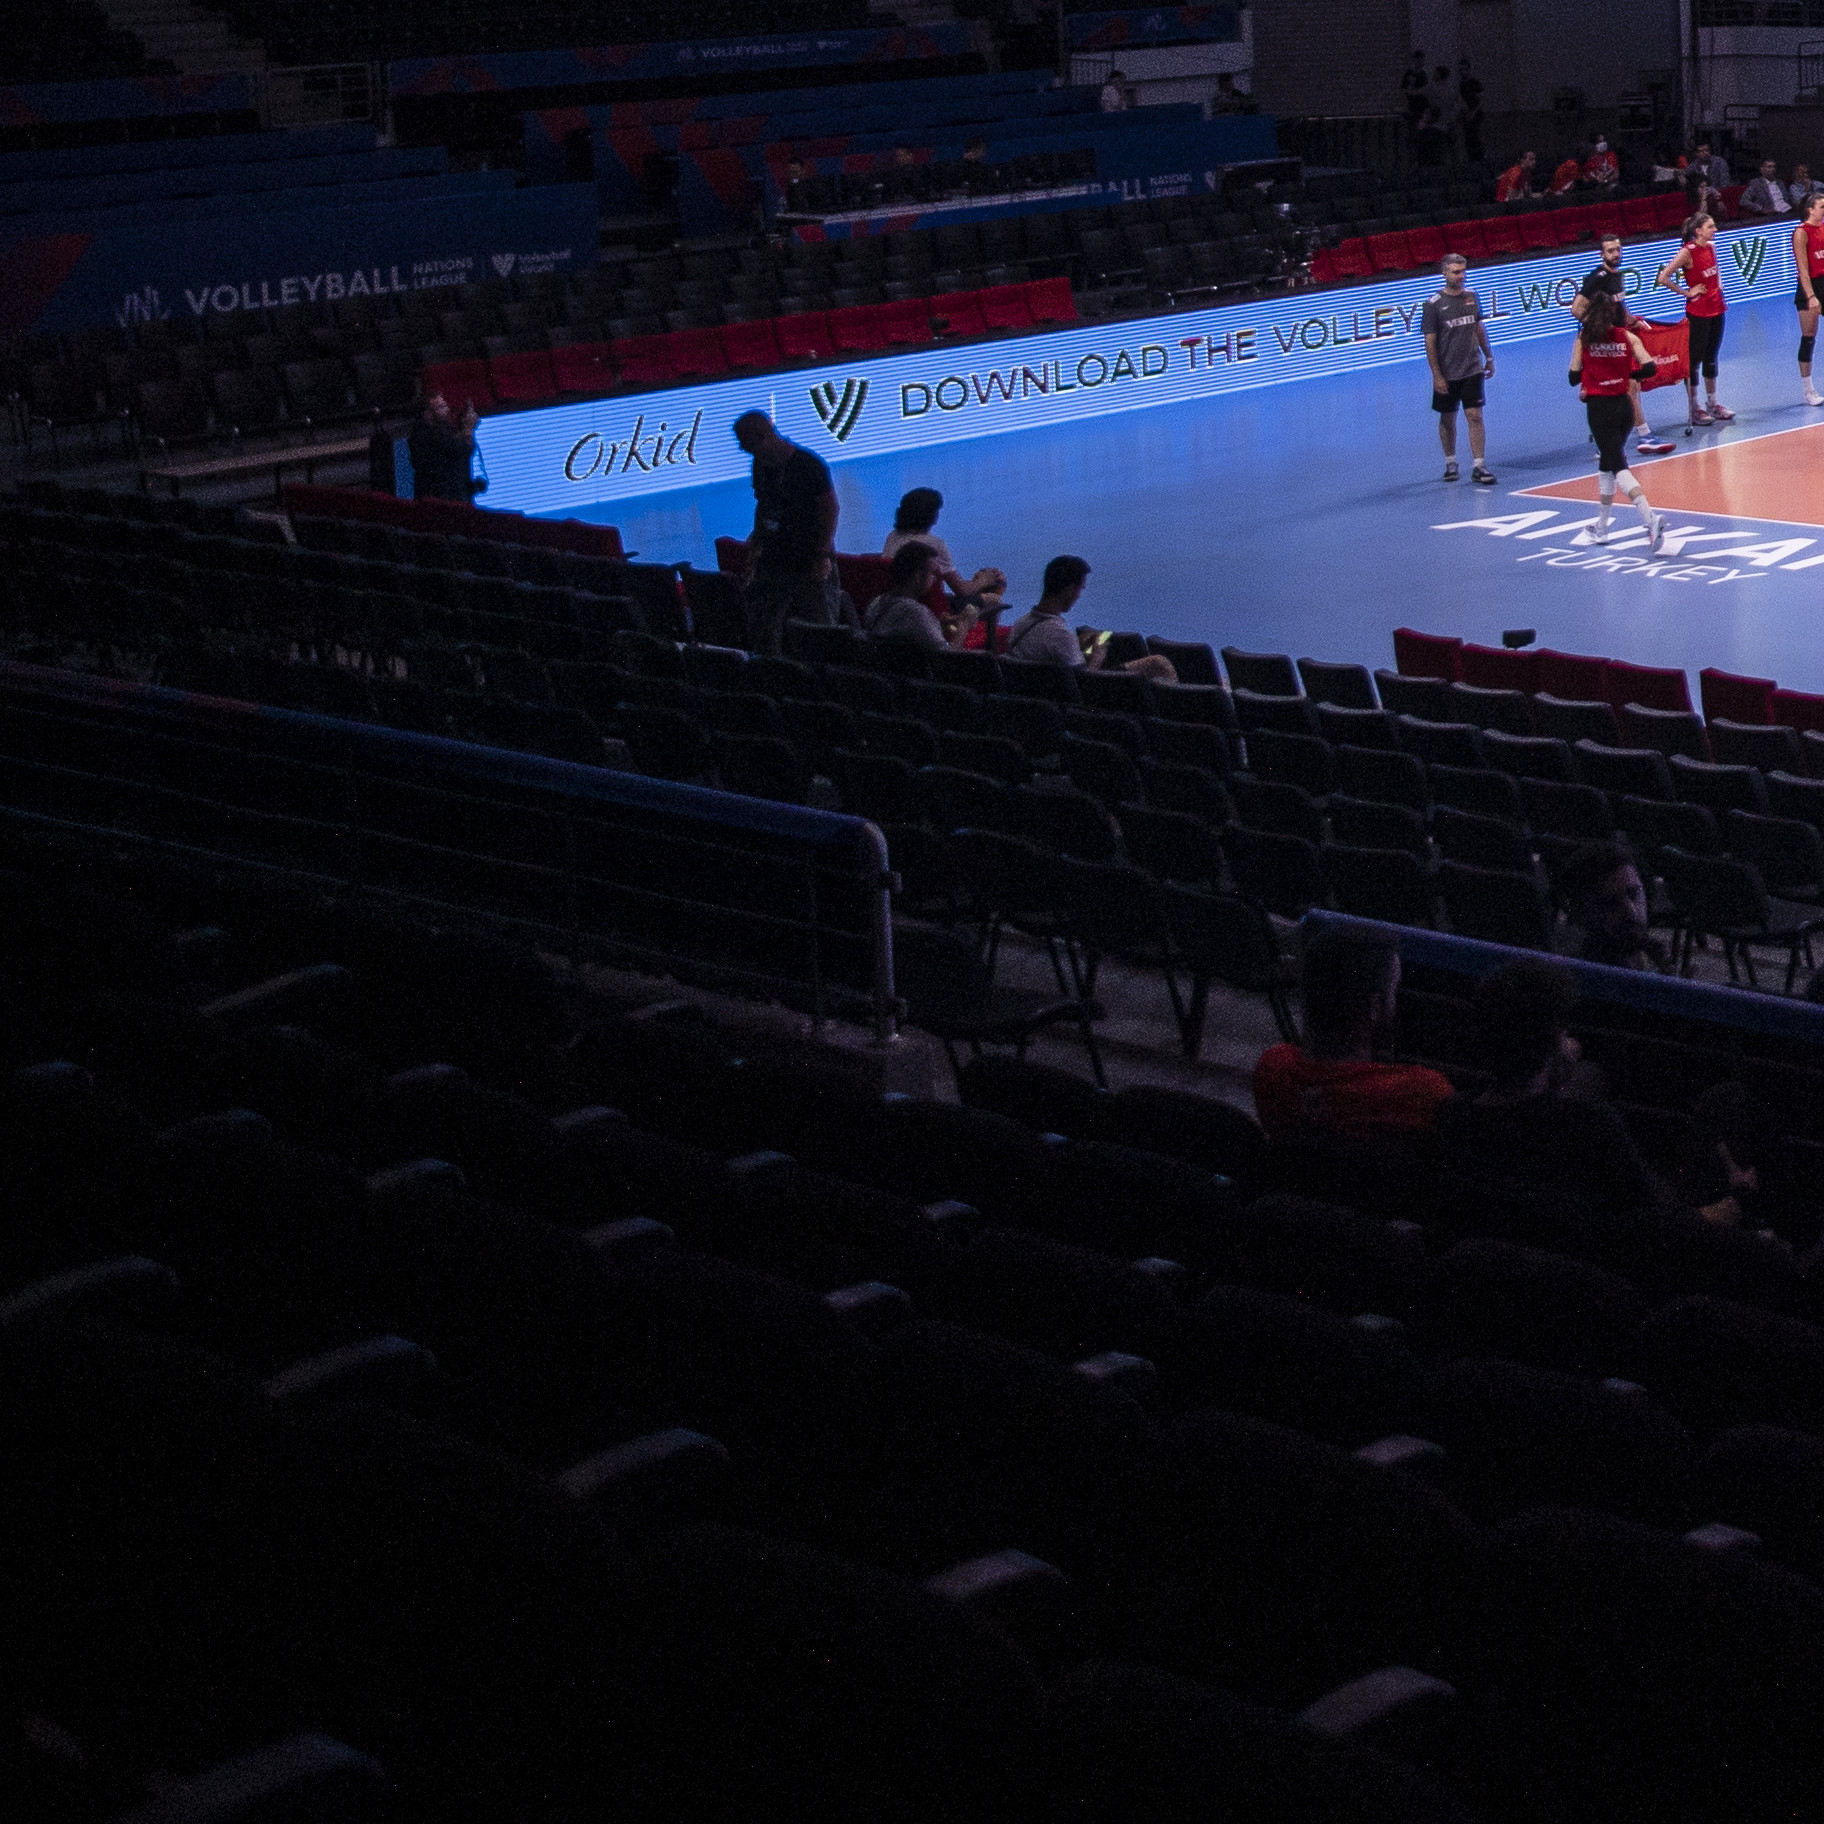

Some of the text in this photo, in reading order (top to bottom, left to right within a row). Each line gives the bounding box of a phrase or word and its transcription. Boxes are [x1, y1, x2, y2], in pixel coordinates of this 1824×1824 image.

[183, 263, 409, 317] VOLLEYBALL
[901, 344, 1169, 418] DOWNLOAD
[1179, 328, 1258, 371] THE
[563, 408, 704, 482] Orkid
[1516, 546, 1770, 585] TURKEY
